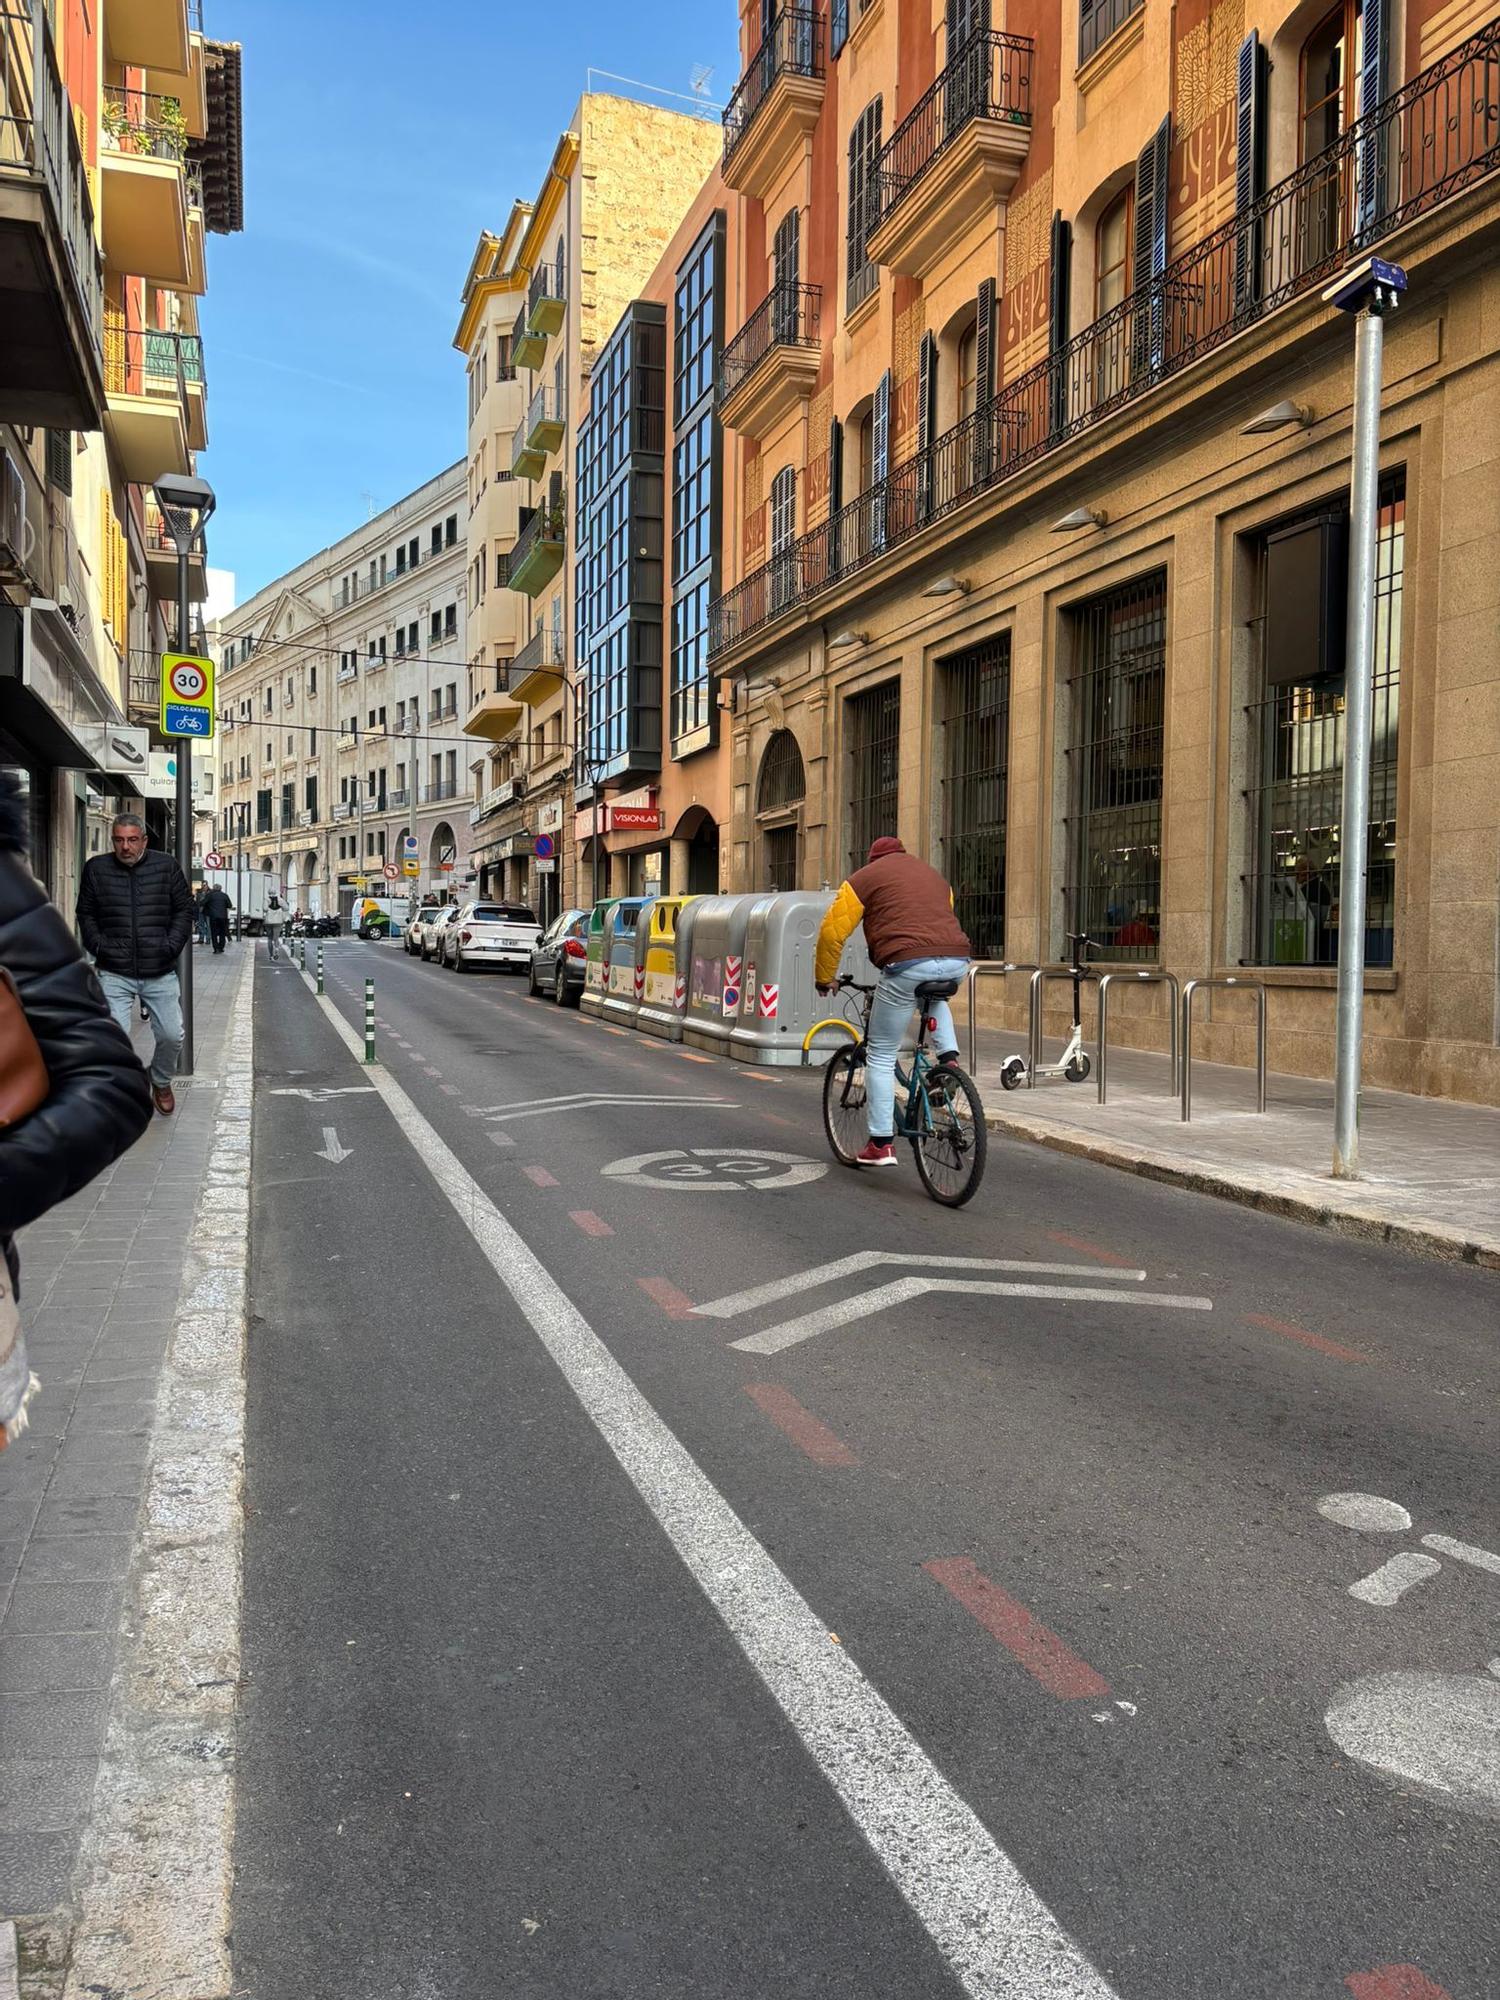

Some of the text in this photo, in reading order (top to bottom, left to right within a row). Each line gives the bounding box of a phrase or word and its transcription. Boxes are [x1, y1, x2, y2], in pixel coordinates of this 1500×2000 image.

[177, 674, 199, 688] 30
[166, 704, 209, 714] CICLOCARRER
[614, 813, 658, 823] VISIONLAB
[660, 1160, 771, 1177] 30
